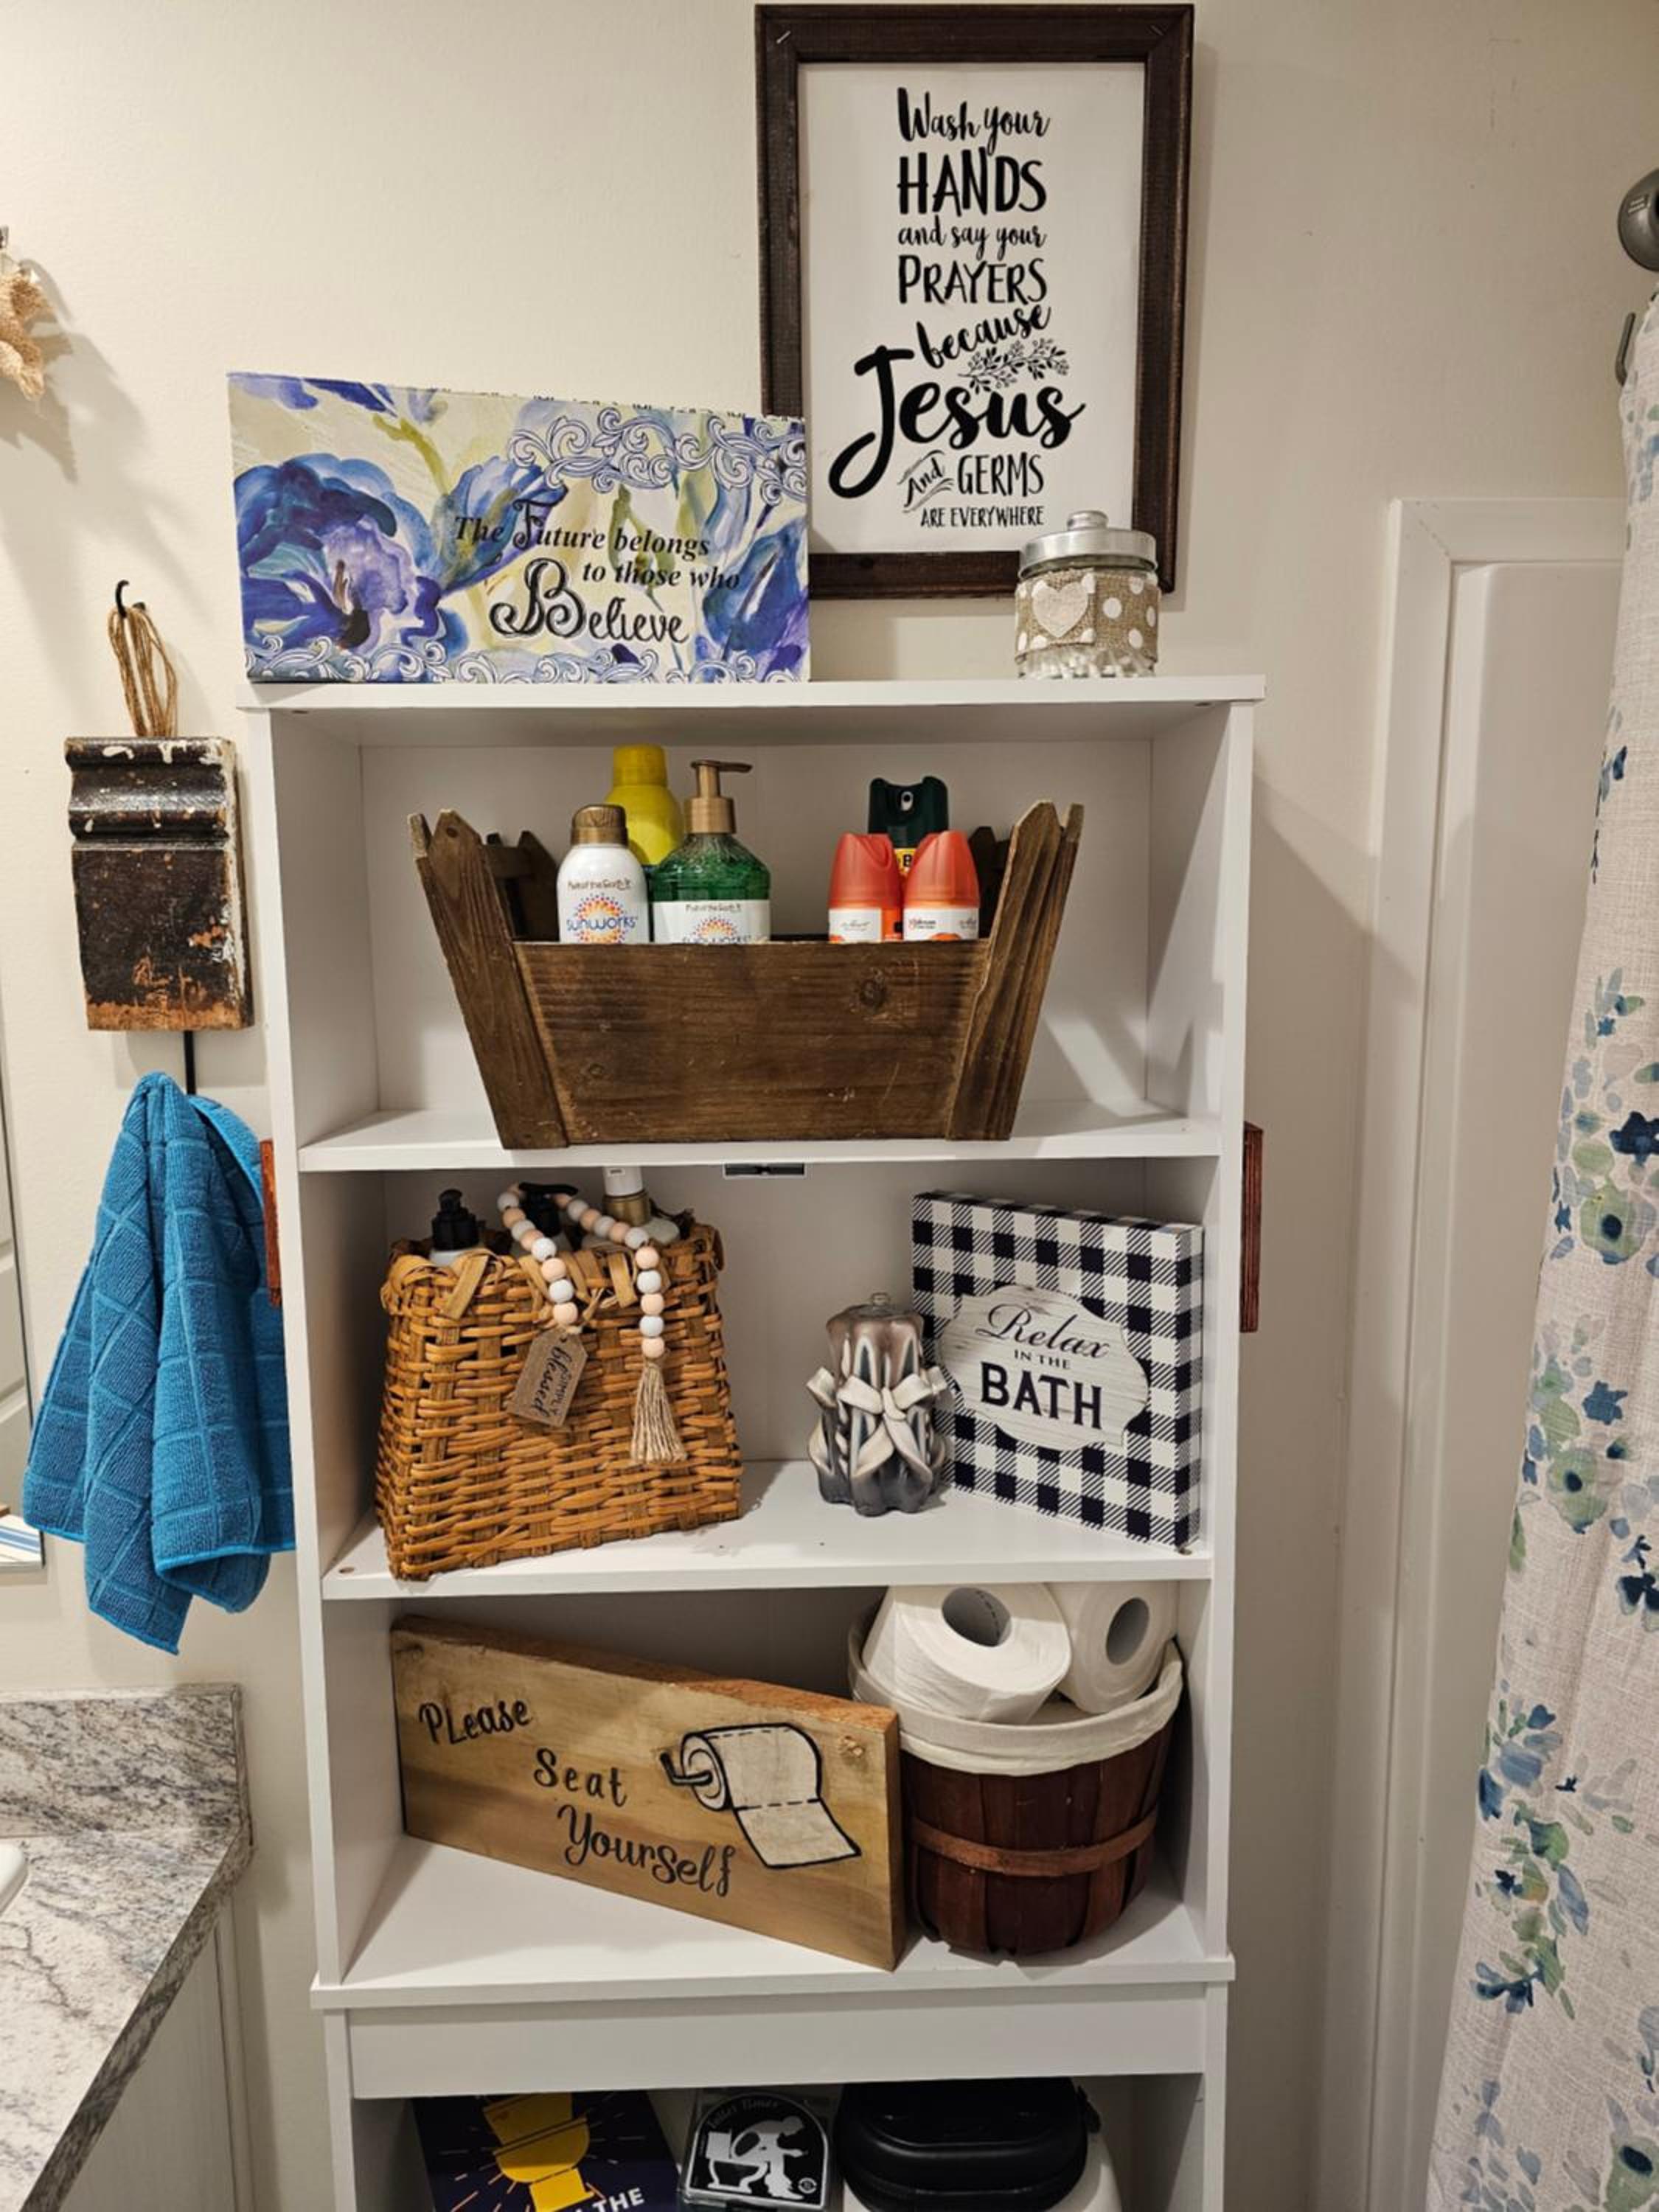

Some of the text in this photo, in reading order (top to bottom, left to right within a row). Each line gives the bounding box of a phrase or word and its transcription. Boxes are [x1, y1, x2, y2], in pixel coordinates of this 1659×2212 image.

[897, 87, 1050, 155] Wash your
[897, 147, 1047, 217] HANDS
[898, 215, 1046, 260] and say your
[899, 255, 1047, 305] PRAYERS
[917, 306, 1051, 369] because
[829, 345, 1086, 498] Jesus
[904, 452, 1044, 507] And GERMS
[454, 498, 710, 560] The Future belongs
[921, 506, 1045, 528] ARE EVERYWHERE
[489, 557, 689, 644] Believe
[582, 560, 740, 589] to those who
[975, 1303, 1110, 1359] Relax
[1015, 1349, 1071, 1370] IN THE
[980, 1361, 1102, 1430] BATH
[534, 1747, 627, 1807] Seat
[592, 2188, 645, 2212] THE
